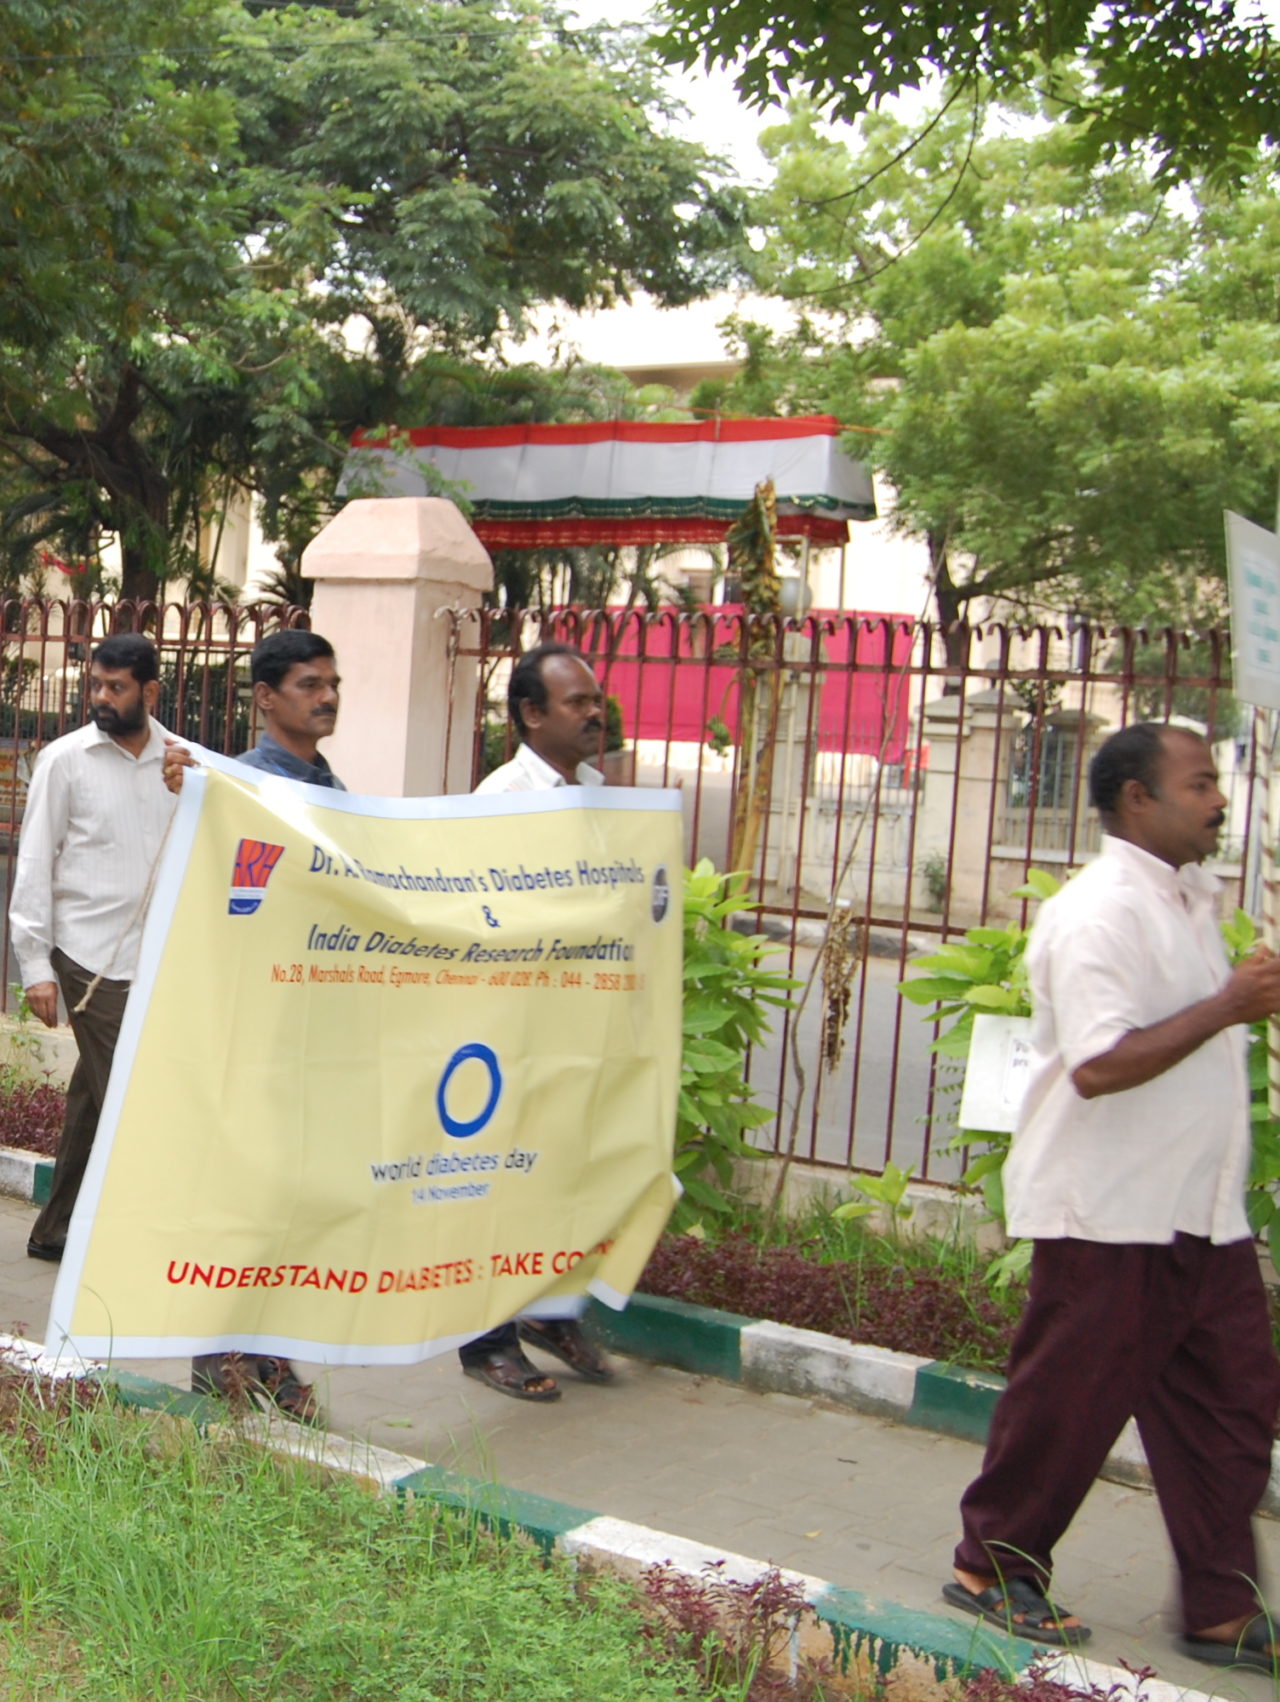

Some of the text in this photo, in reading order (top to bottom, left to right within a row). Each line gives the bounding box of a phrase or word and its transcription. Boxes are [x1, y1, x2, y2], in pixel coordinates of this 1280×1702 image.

[308, 843, 338, 876] Dr.
[488, 864, 573, 892] Diabetes
[576, 857, 645, 890] Hospitals
[482, 905, 501, 928] &
[307, 923, 360, 951] India
[364, 930, 459, 961] Diabetes
[459, 938, 544, 963] Research
[371, 1147, 537, 1181] world diabetes day
[428, 1181, 490, 1200] November
[167, 1260, 368, 1294] UNDERSTAND
[377, 1258, 474, 1294] DIABETES
[490, 1251, 544, 1277] TAKE
